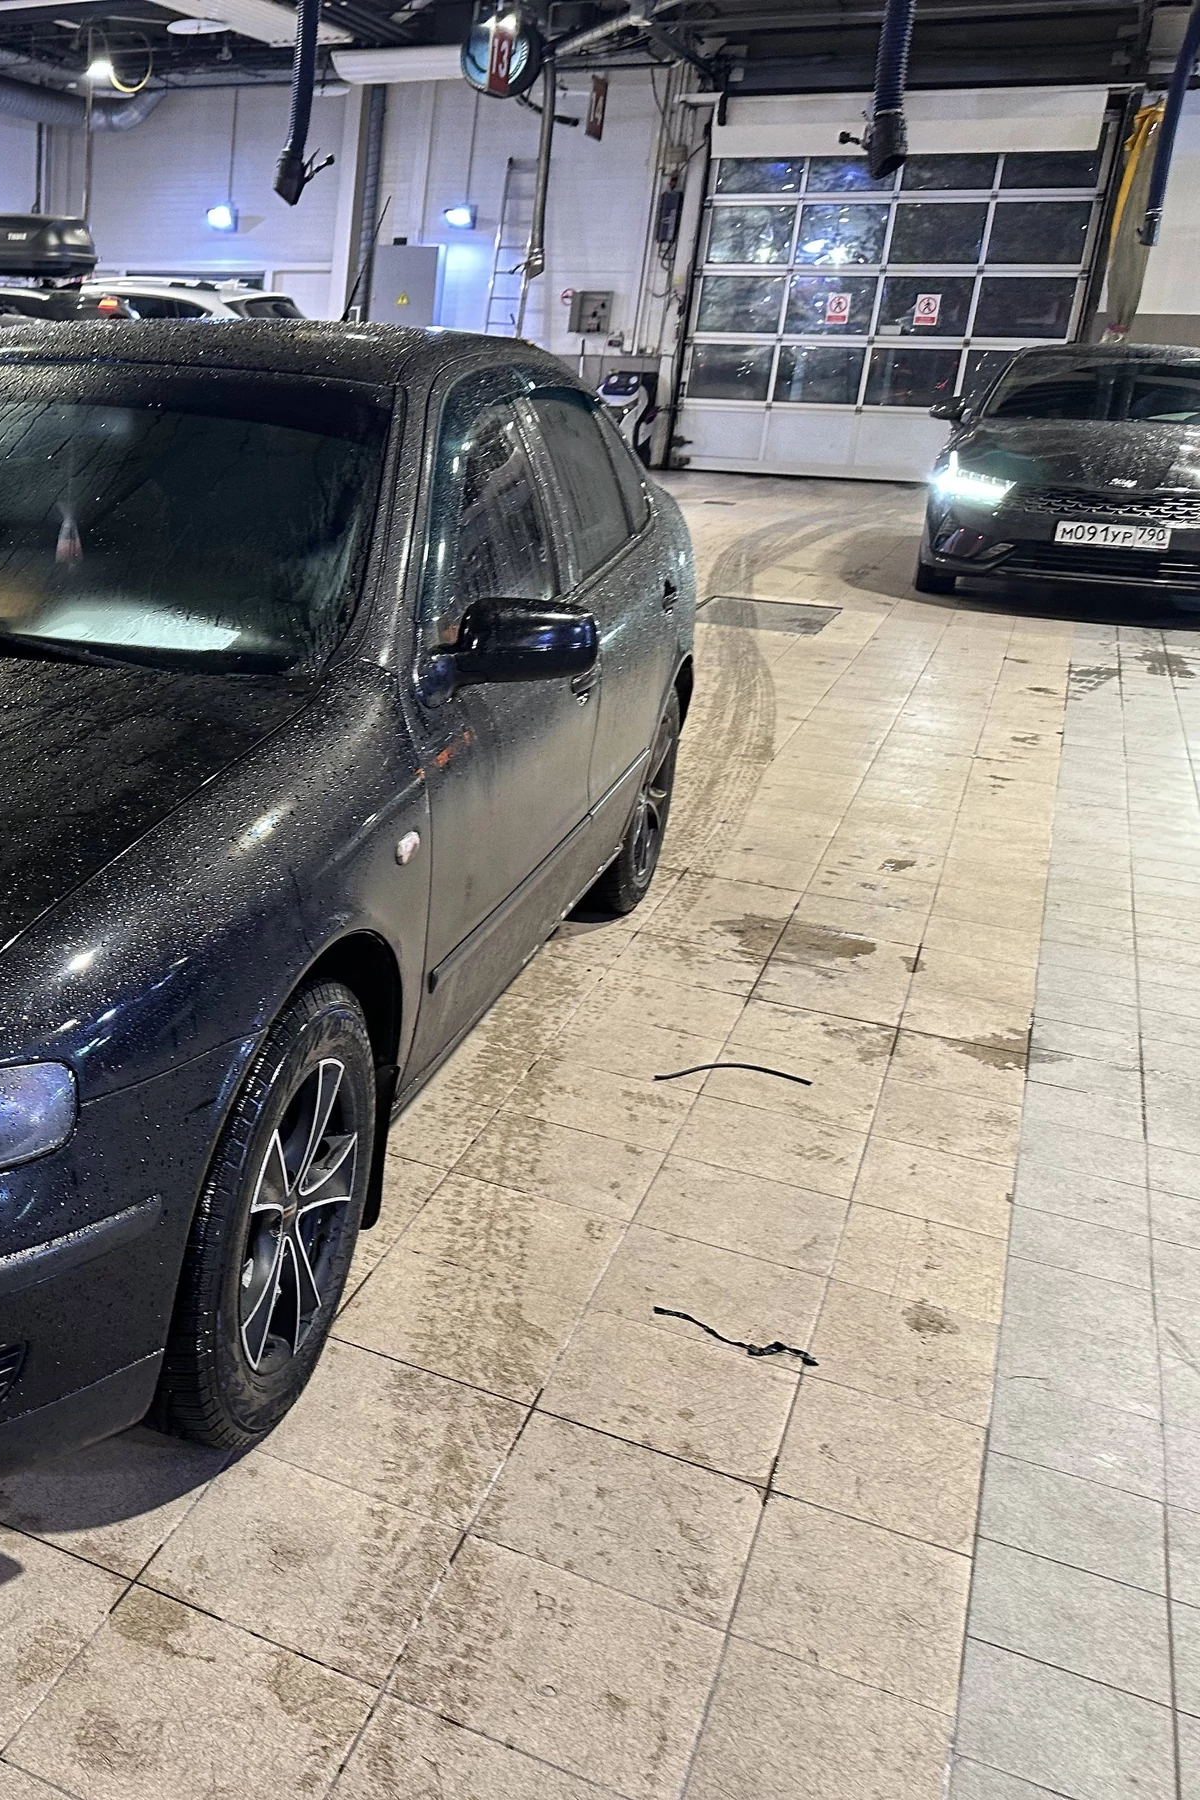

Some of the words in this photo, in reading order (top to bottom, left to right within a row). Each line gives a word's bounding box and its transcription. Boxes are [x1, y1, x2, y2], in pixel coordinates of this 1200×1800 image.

[491, 38, 509, 78] 13
[589, 92, 604, 126] 14
[1060, 525, 1133, 543] М091УР
[1138, 527, 1165, 541] 790
